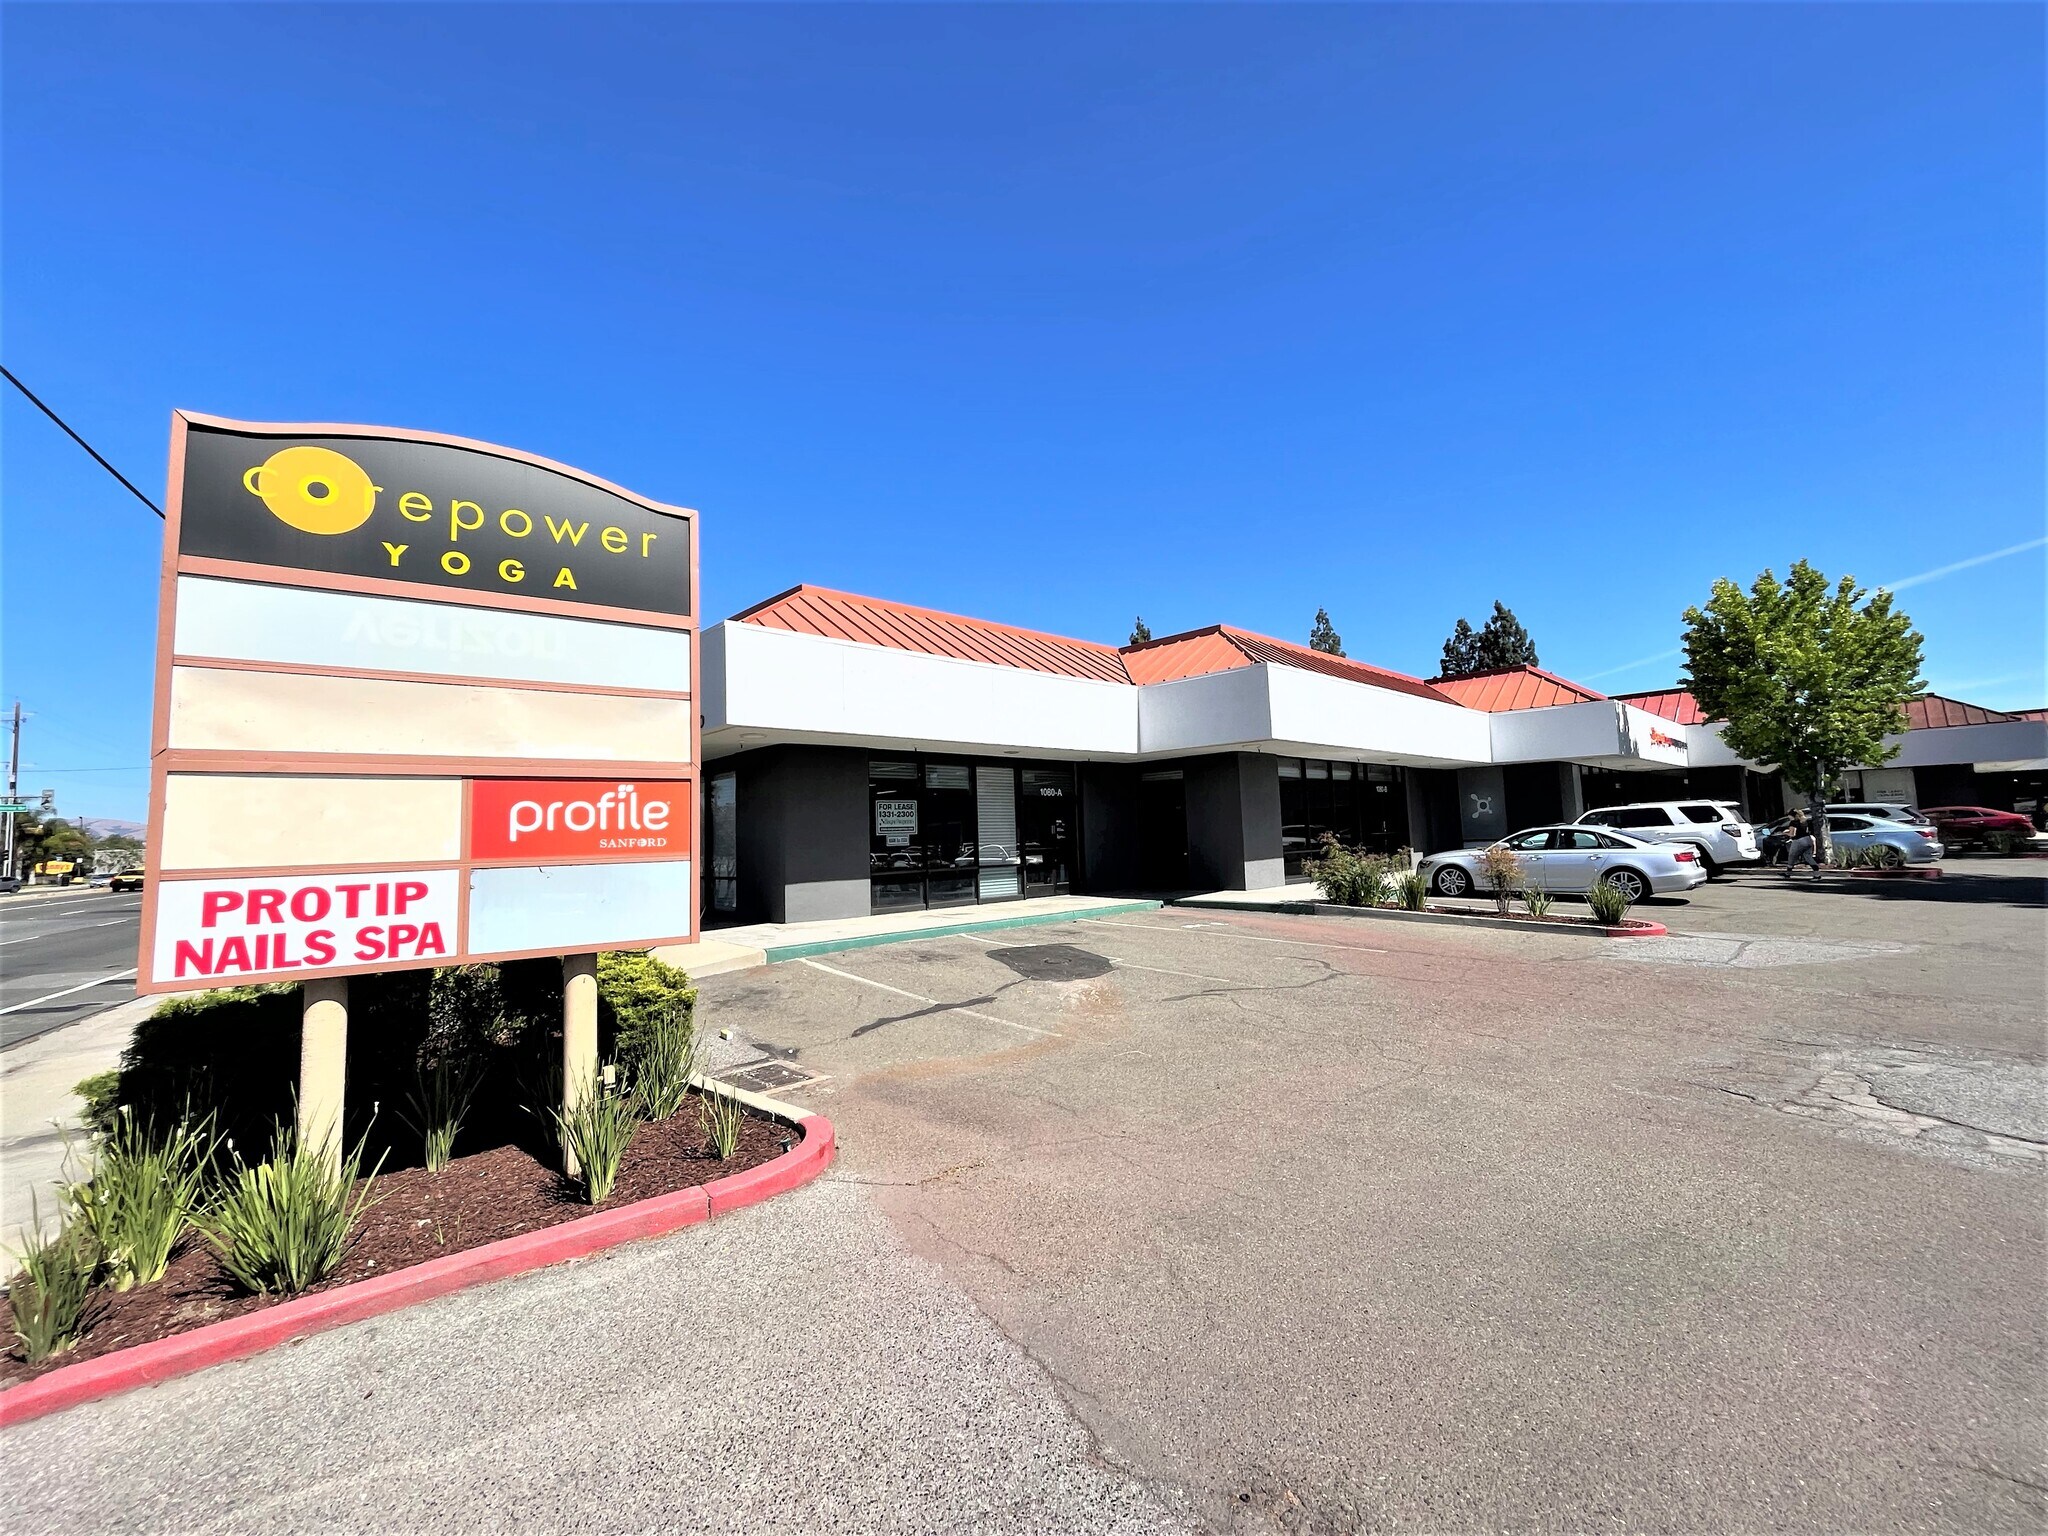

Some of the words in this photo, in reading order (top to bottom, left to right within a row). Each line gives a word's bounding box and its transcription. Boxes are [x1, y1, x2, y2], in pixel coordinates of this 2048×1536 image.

[382, 540, 579, 590] YOGA
[508, 786, 670, 843] profile
[599, 838, 667, 849] SANFORD
[201, 882, 429, 928] PROTIP
[174, 930, 336, 978] NAILS
[354, 922, 446, 961] SPA
